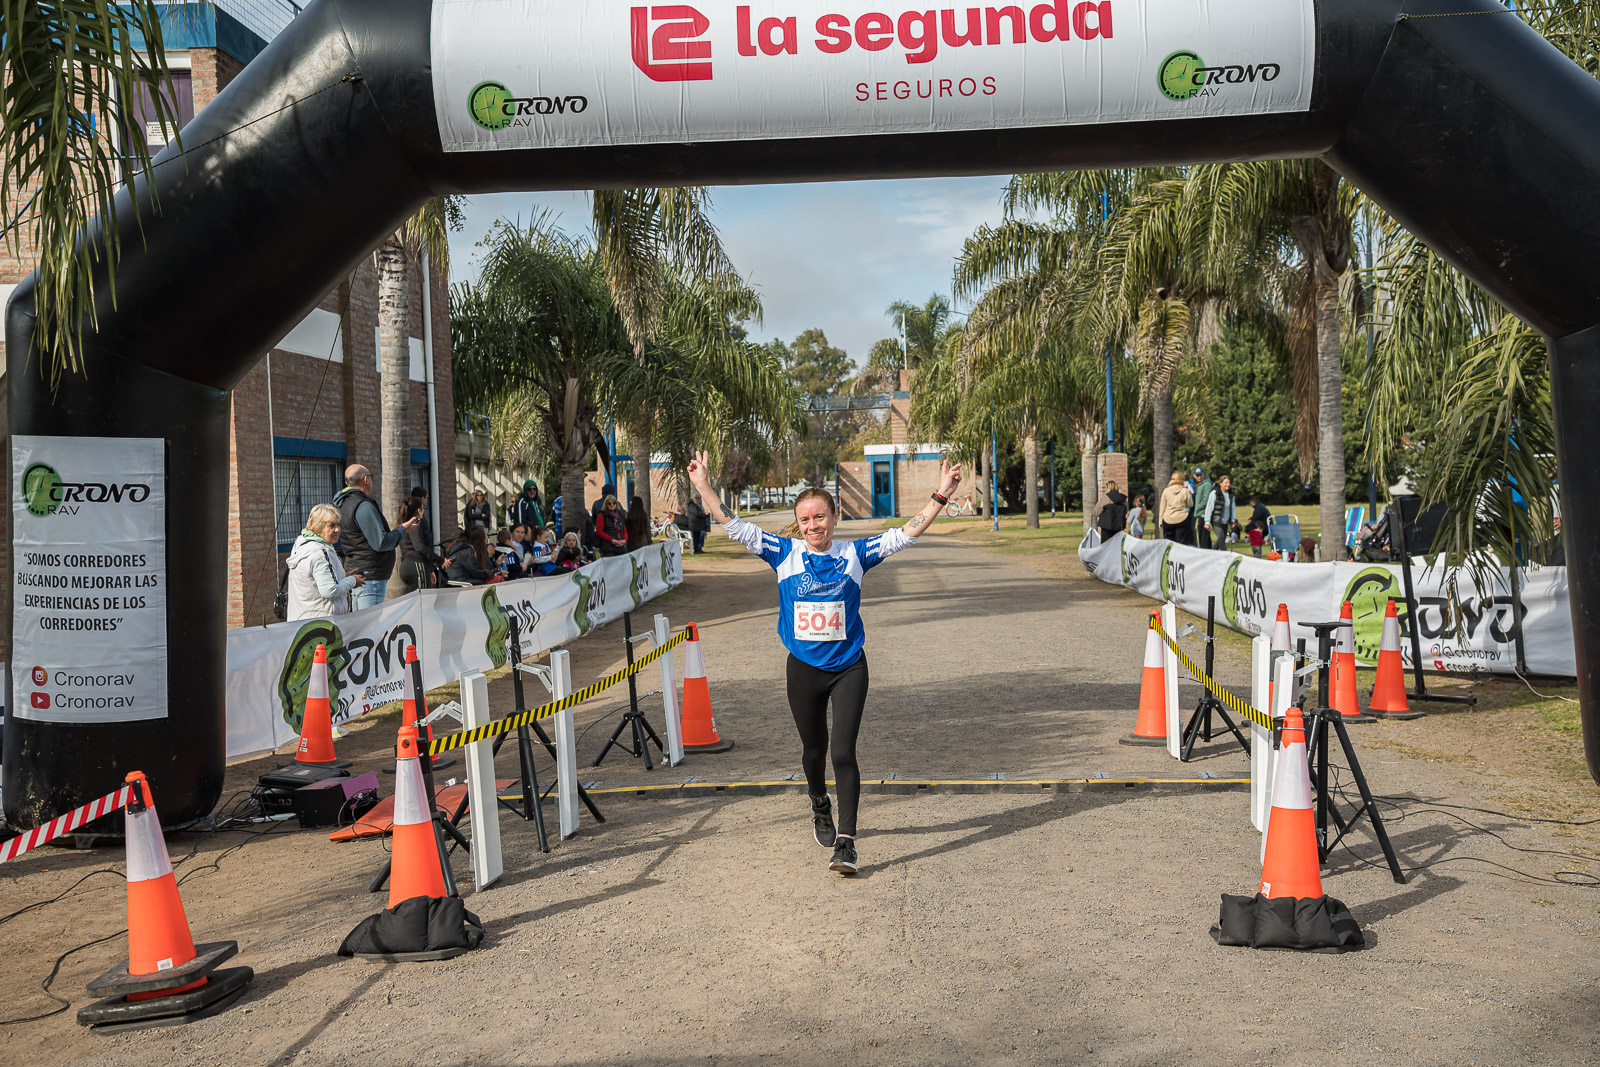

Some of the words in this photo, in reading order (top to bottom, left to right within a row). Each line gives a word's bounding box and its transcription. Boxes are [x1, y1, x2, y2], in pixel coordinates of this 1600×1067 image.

[736, 5, 798, 57] la
[814, 0, 1114, 64] segunda
[1191, 63, 1281, 86] CRONO
[855, 76, 997, 102] SEGUROS
[1188, 87, 1220, 98] RAV
[501, 95, 588, 116] CRONO
[501, 117, 532, 128] RAV
[49, 482, 151, 504] CRONO
[47, 505, 81, 516] RAV
[24, 552, 61, 568] “SOMOS
[63, 554, 147, 568] CORREDORES
[17, 572, 68, 589] BUSCANDO
[71, 575, 132, 589] MEJORAR
[135, 574, 158, 588] LAS
[24, 594, 100, 610] EXPERIENCIAS
[103, 597, 120, 610] DE
[123, 596, 146, 609] LOS
[39, 616, 123, 631] CORREDORES”
[797, 611, 843, 632] 504
[54, 671, 135, 687] Cronorav
[54, 693, 135, 709] Cronorav
